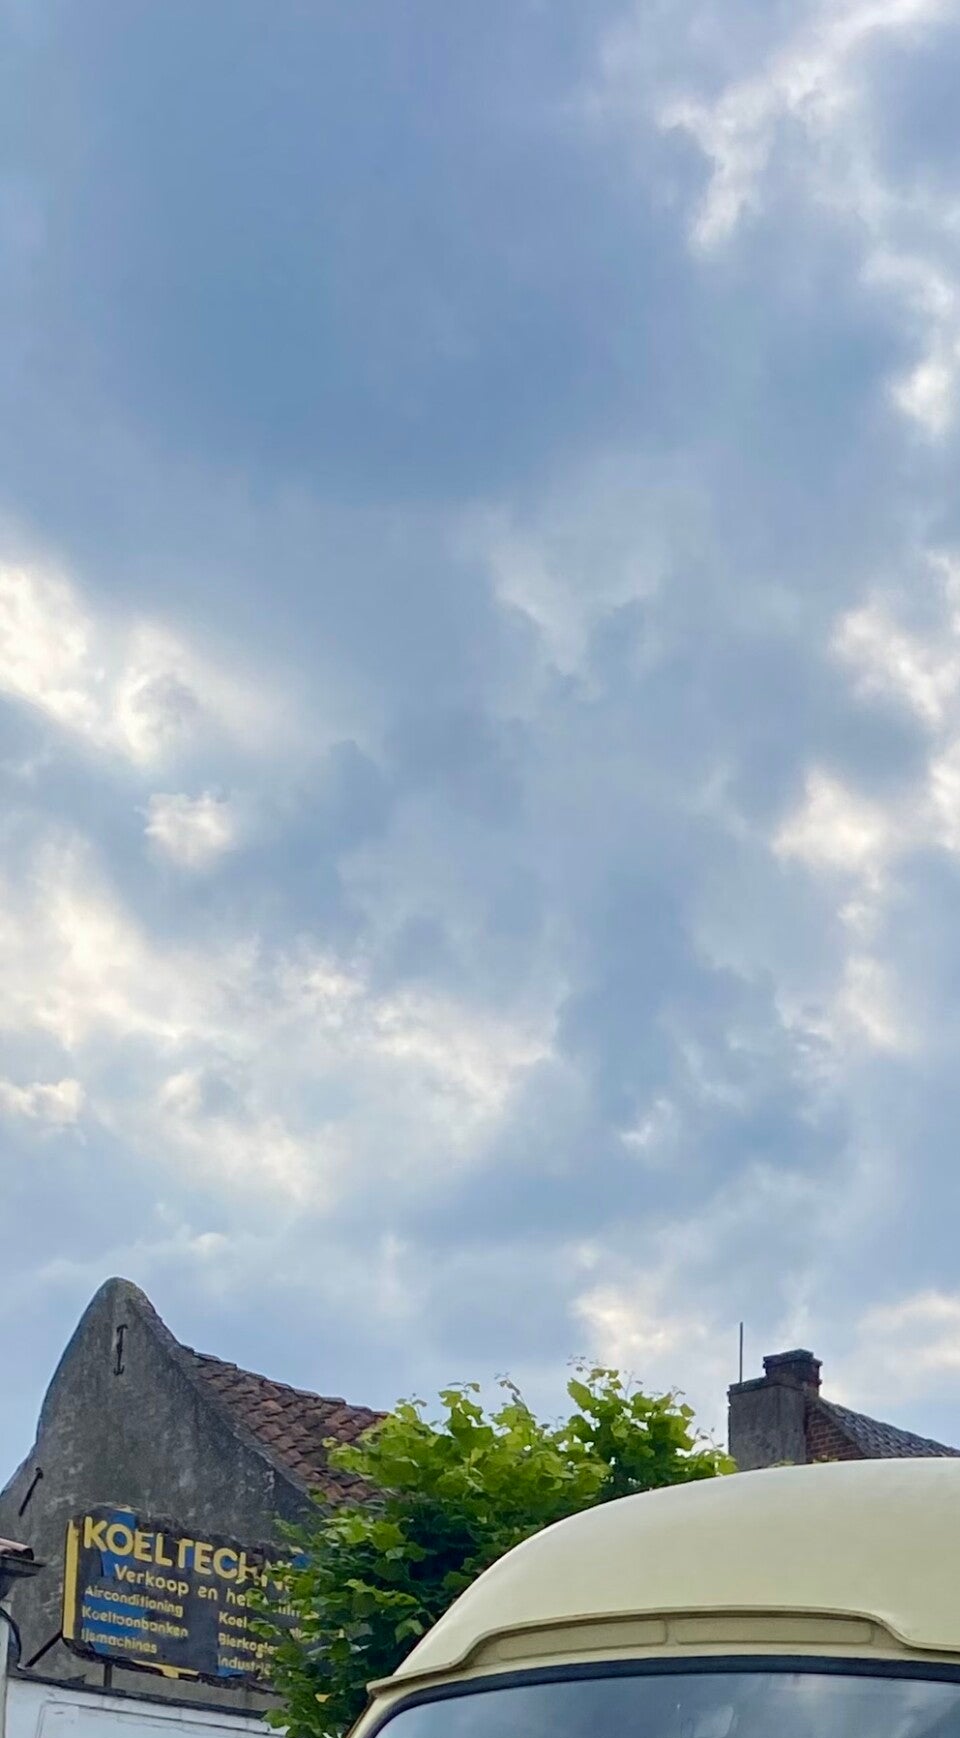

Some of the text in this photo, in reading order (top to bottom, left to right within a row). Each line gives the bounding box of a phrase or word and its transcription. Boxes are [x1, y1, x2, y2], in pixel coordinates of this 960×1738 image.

[115, 1563, 189, 1598] Verkoop
[198, 1585, 219, 1601] en
[85, 1585, 184, 1619] Airconditioning
[82, 1605, 189, 1638] Koeltoonbanken
